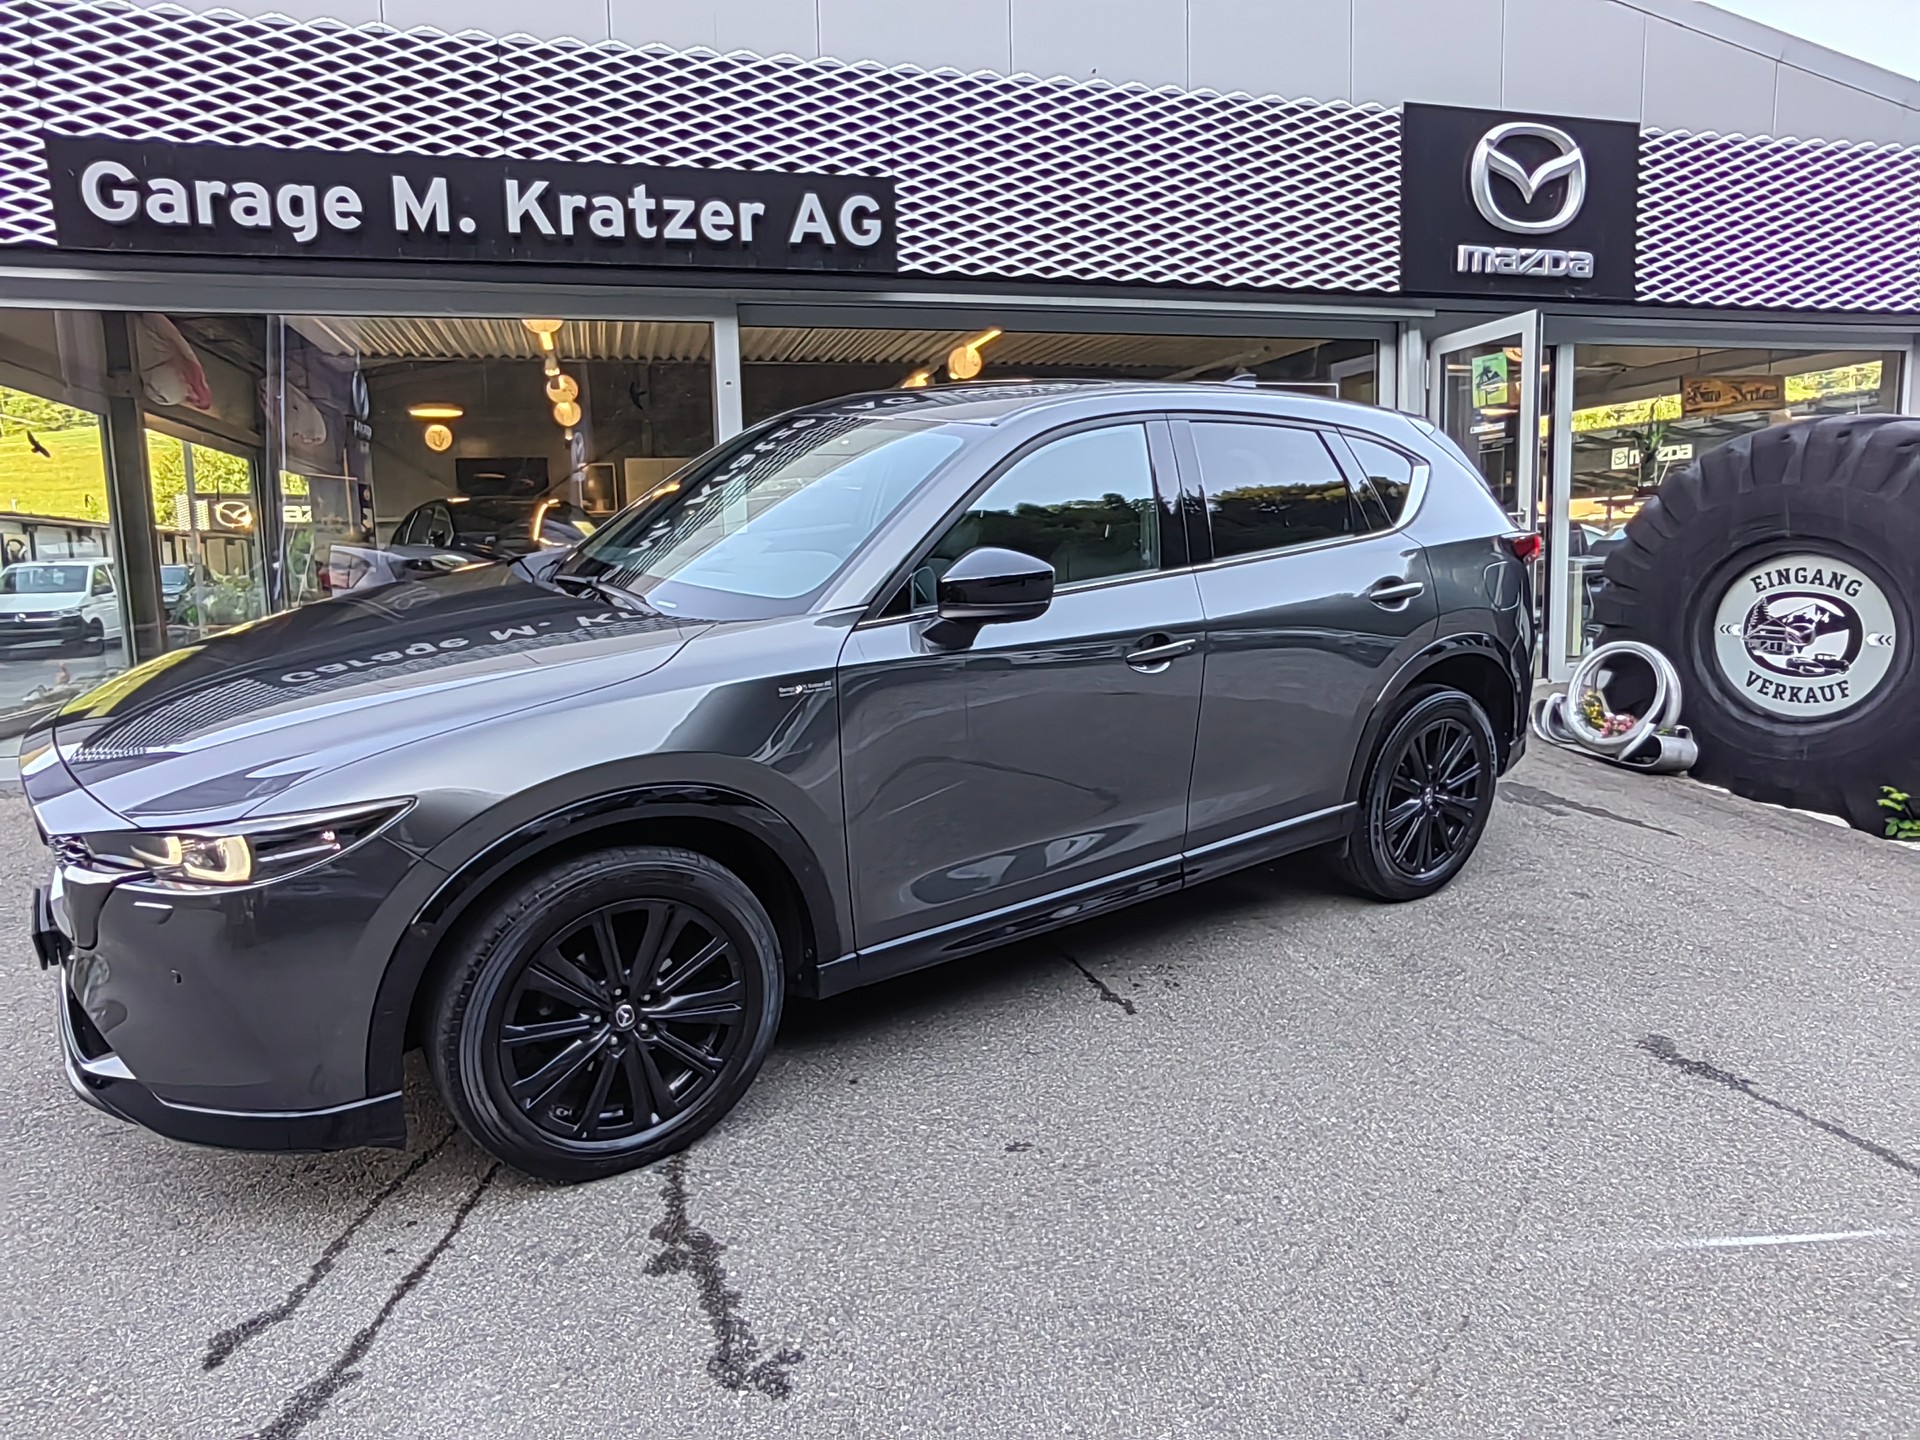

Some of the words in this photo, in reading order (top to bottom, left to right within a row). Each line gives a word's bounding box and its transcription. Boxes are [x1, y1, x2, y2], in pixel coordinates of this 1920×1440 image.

[80, 160, 363, 243] Garage
[391, 175, 477, 234] M.
[505, 178, 766, 242] Kratzer
[788, 192, 883, 247] AG
[1456, 244, 1594, 279] mazda
[1629, 444, 1693, 465] mzda
[1750, 567, 1863, 598] EINGANG
[1746, 670, 1850, 704] VERKAUF
